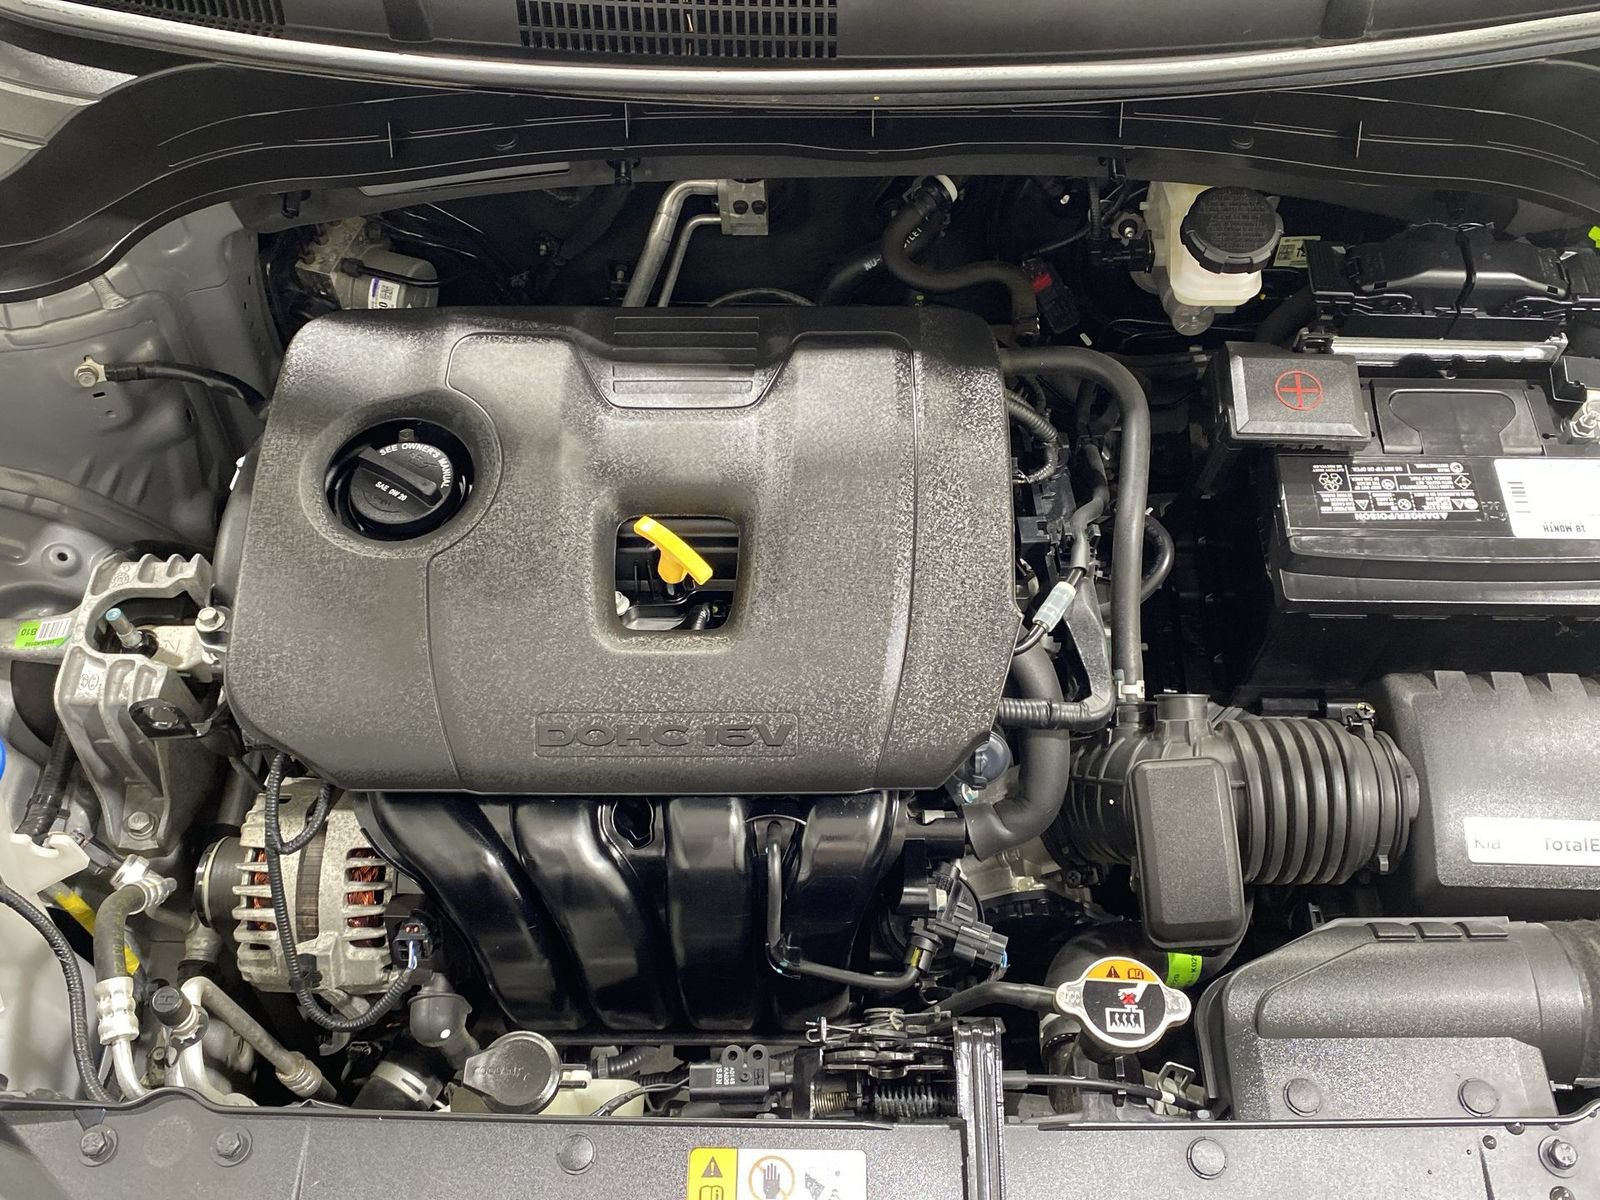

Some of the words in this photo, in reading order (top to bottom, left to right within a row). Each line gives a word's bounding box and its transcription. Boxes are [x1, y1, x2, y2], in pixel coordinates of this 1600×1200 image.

[379, 445, 398, 456] SEE
[402, 443, 440, 458] OWNER'S
[438, 459, 452, 488] MANUAL
[375, 481, 390, 492] SAE
[538, 723, 690, 747] DOHC
[704, 723, 792, 747] 16V
